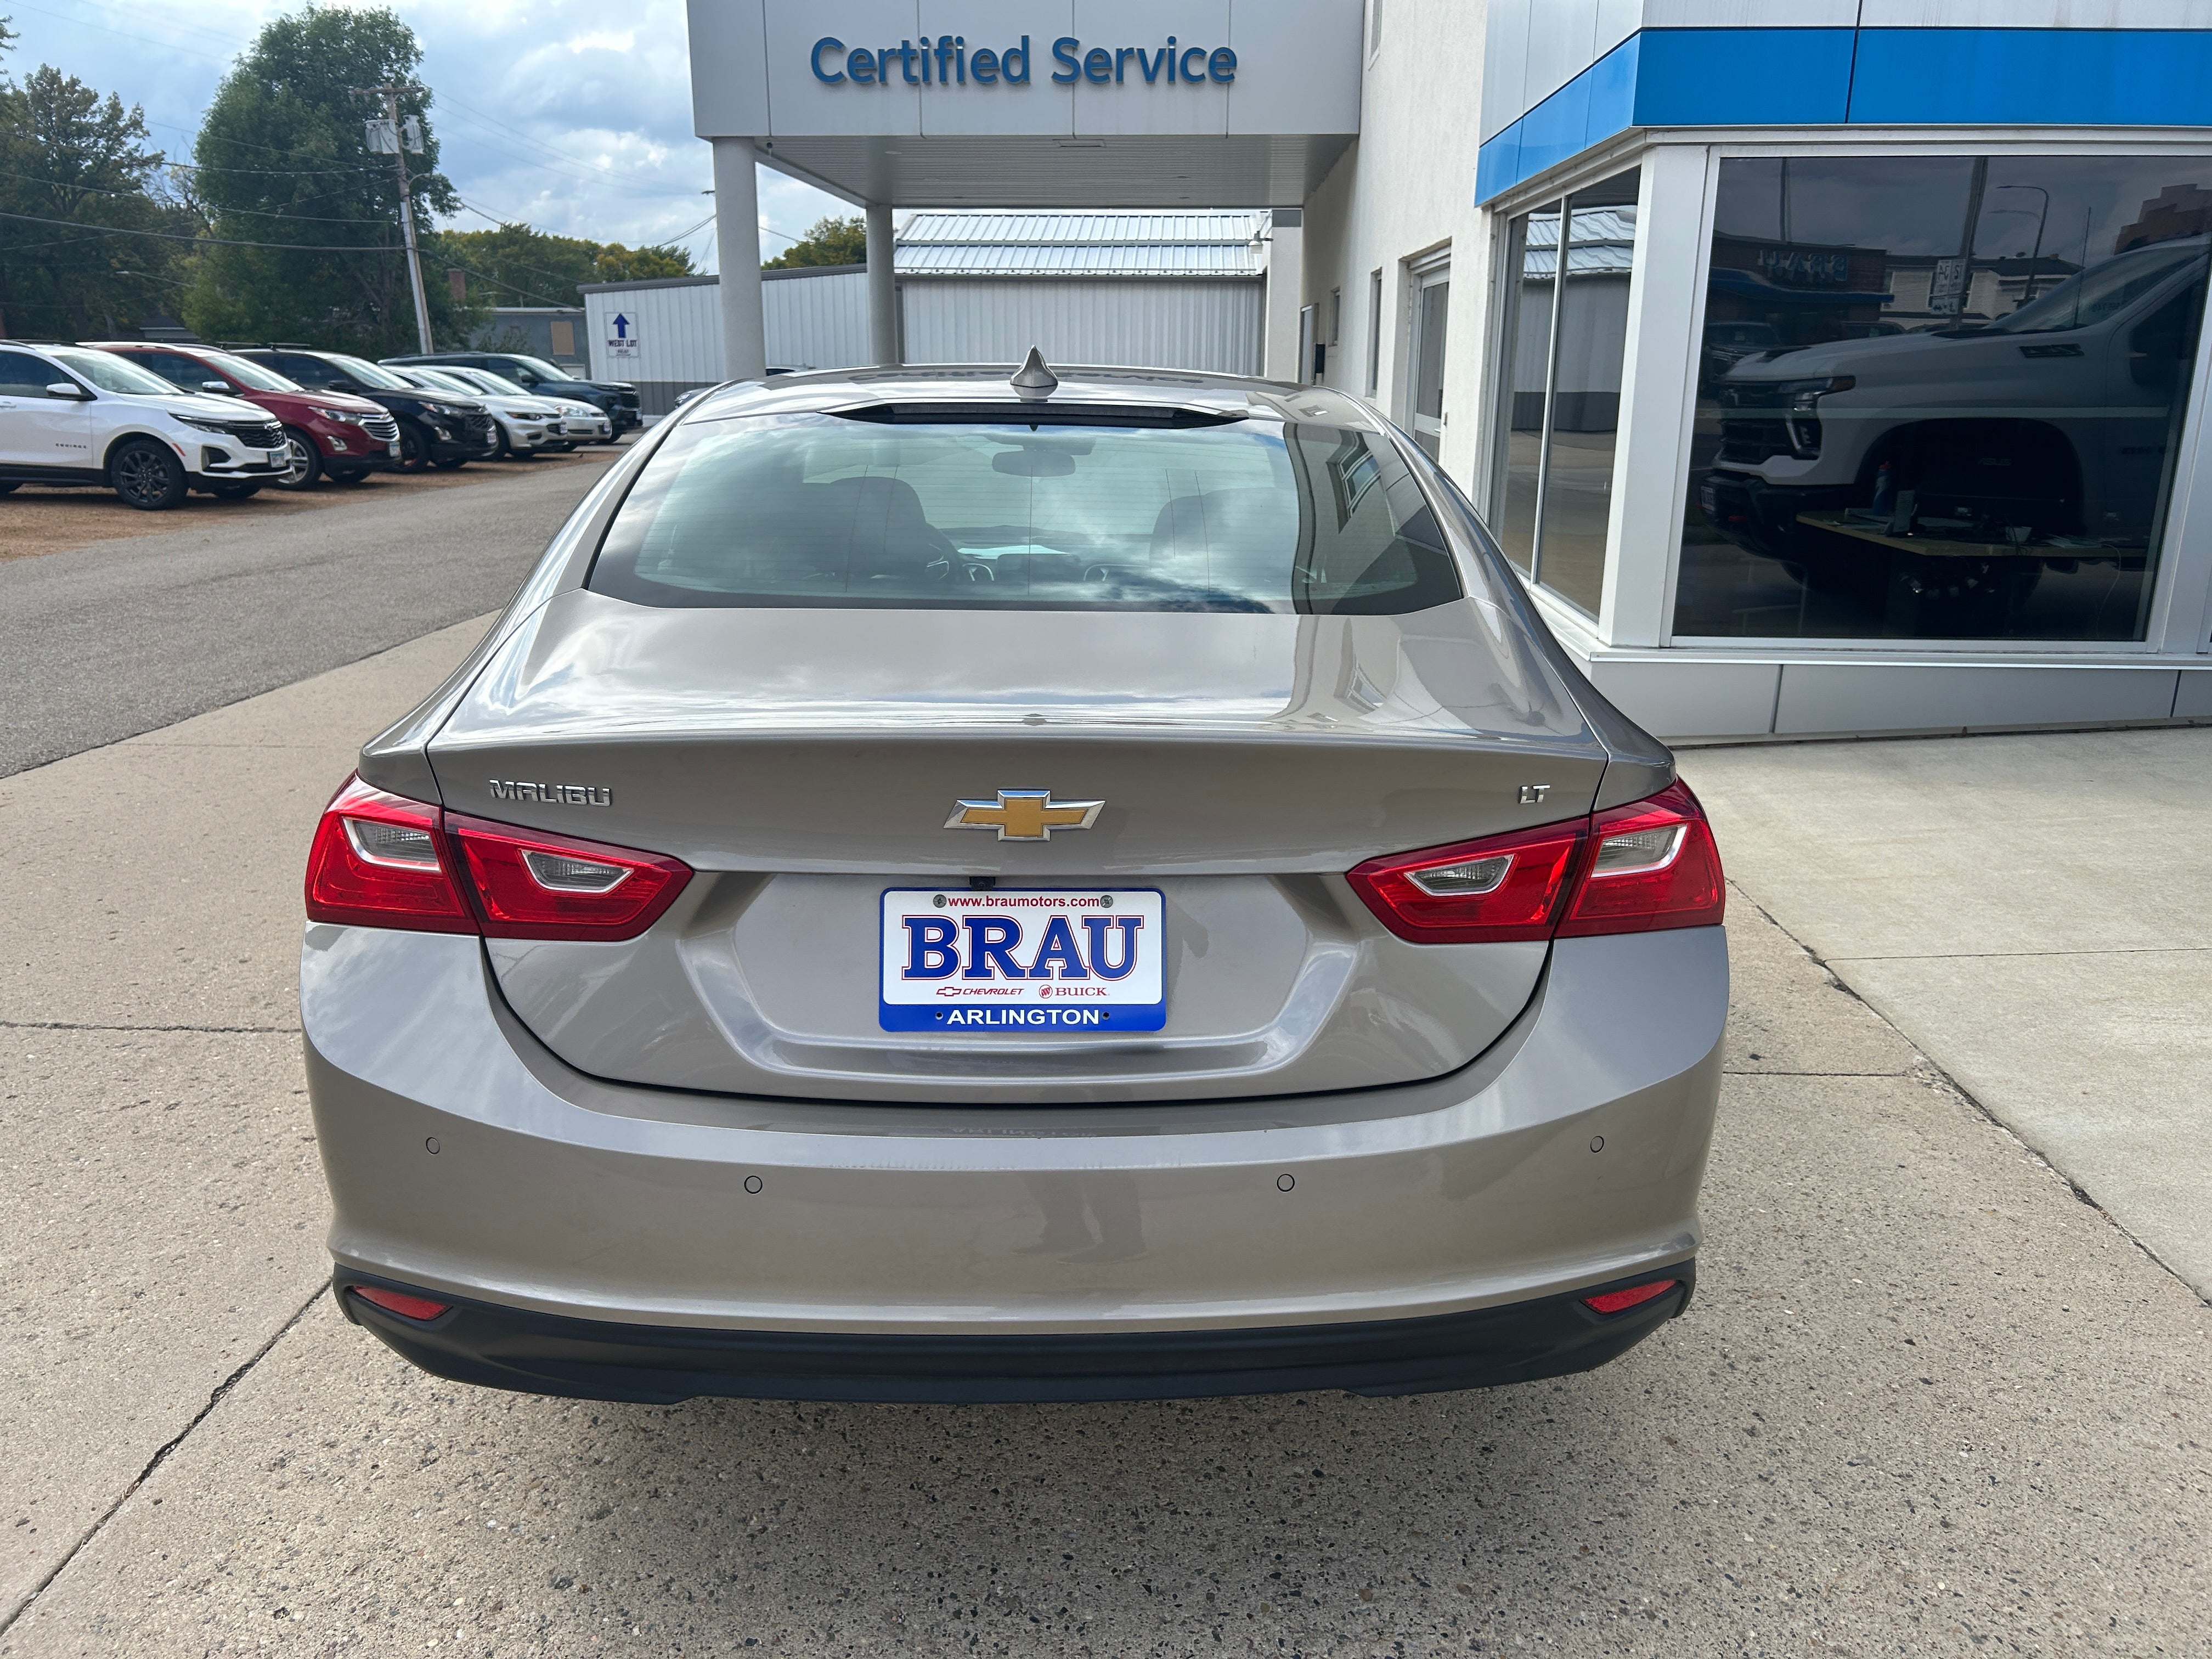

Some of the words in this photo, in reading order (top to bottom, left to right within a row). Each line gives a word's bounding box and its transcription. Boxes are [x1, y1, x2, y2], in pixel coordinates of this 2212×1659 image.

[810, 35, 1030, 84] Certified
[1051, 35, 1238, 84] Service
[488, 778, 612, 807] MALIBU
[1519, 785, 1550, 804] LT
[948, 895, 1100, 907] www.braumotors.com
[901, 915, 1144, 981] BRAU
[1054, 987, 1108, 996] BUICK
[946, 1009, 1099, 1025] ARLINGTON
